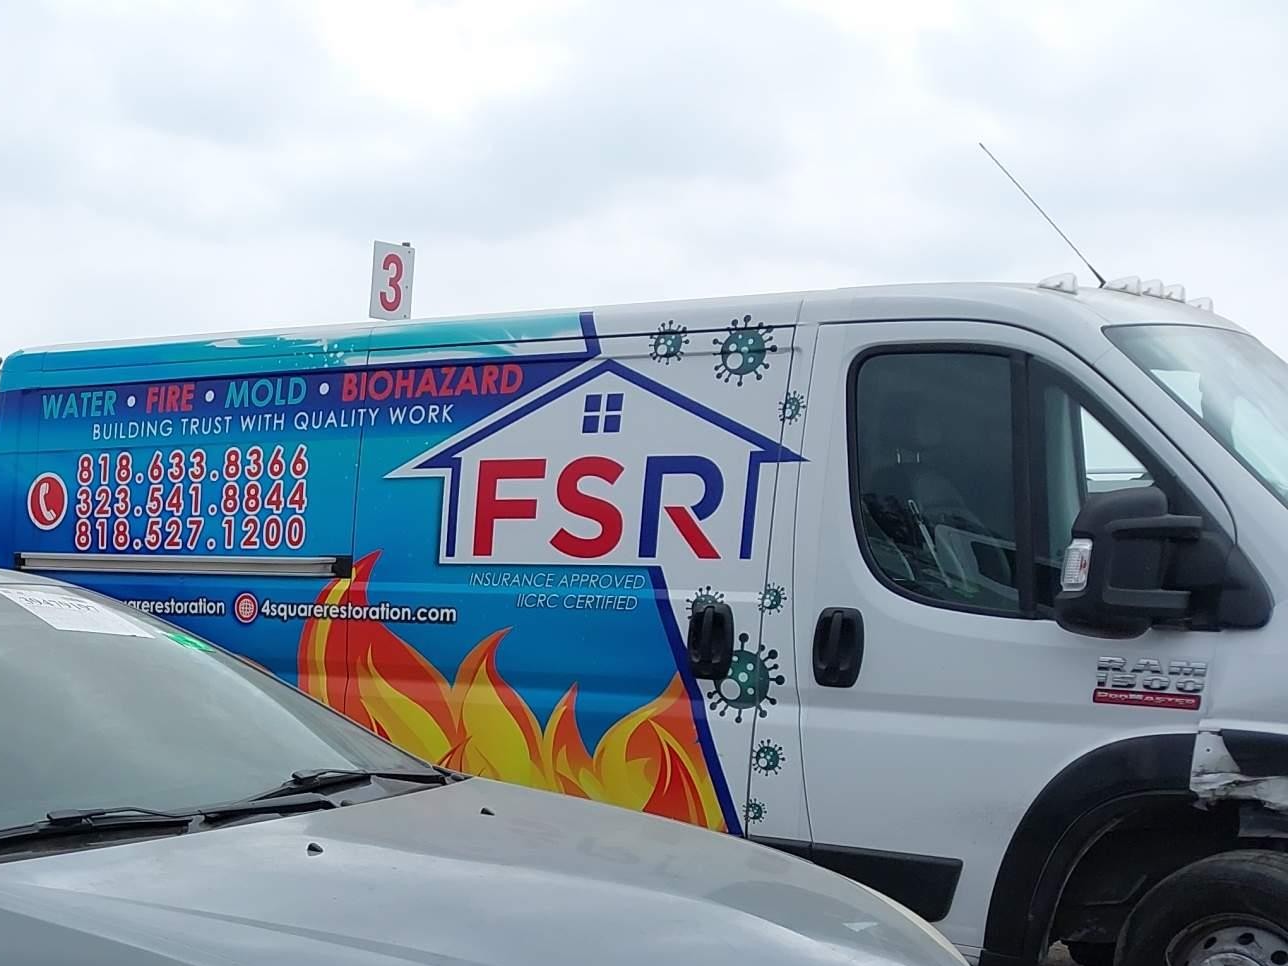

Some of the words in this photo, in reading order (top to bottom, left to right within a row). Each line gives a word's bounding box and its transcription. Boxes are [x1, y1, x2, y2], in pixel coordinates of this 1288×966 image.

[379, 253, 404, 312] 3
[42, 389, 117, 419] WATER
[146, 383, 195, 413] FIRE
[224, 377, 307, 408] MOLD
[341, 363, 524, 402] BIOHAZARD
[92, 419, 173, 440] BUILDING
[180, 415, 232, 437] TRUST
[240, 412, 285, 433] WITH
[294, 407, 380, 431] QUALITY
[389, 404, 454, 424] WORK
[77, 444, 311, 486] 818.633.8366
[76, 479, 307, 518] 323.541.8844
[472, 456, 722, 559] FSR
[75, 514, 306, 551] 818.527.1200
[469, 572, 555, 588] INSURANCE
[559, 573, 646, 589] APPROVED
[261, 599, 457, 622] 4squarerestoration.com
[516, 593, 561, 608] IICRC
[563, 594, 638, 610] CERTIFIED
[1096, 672, 1205, 693] 1500
[1097, 656, 1208, 677] RAM
